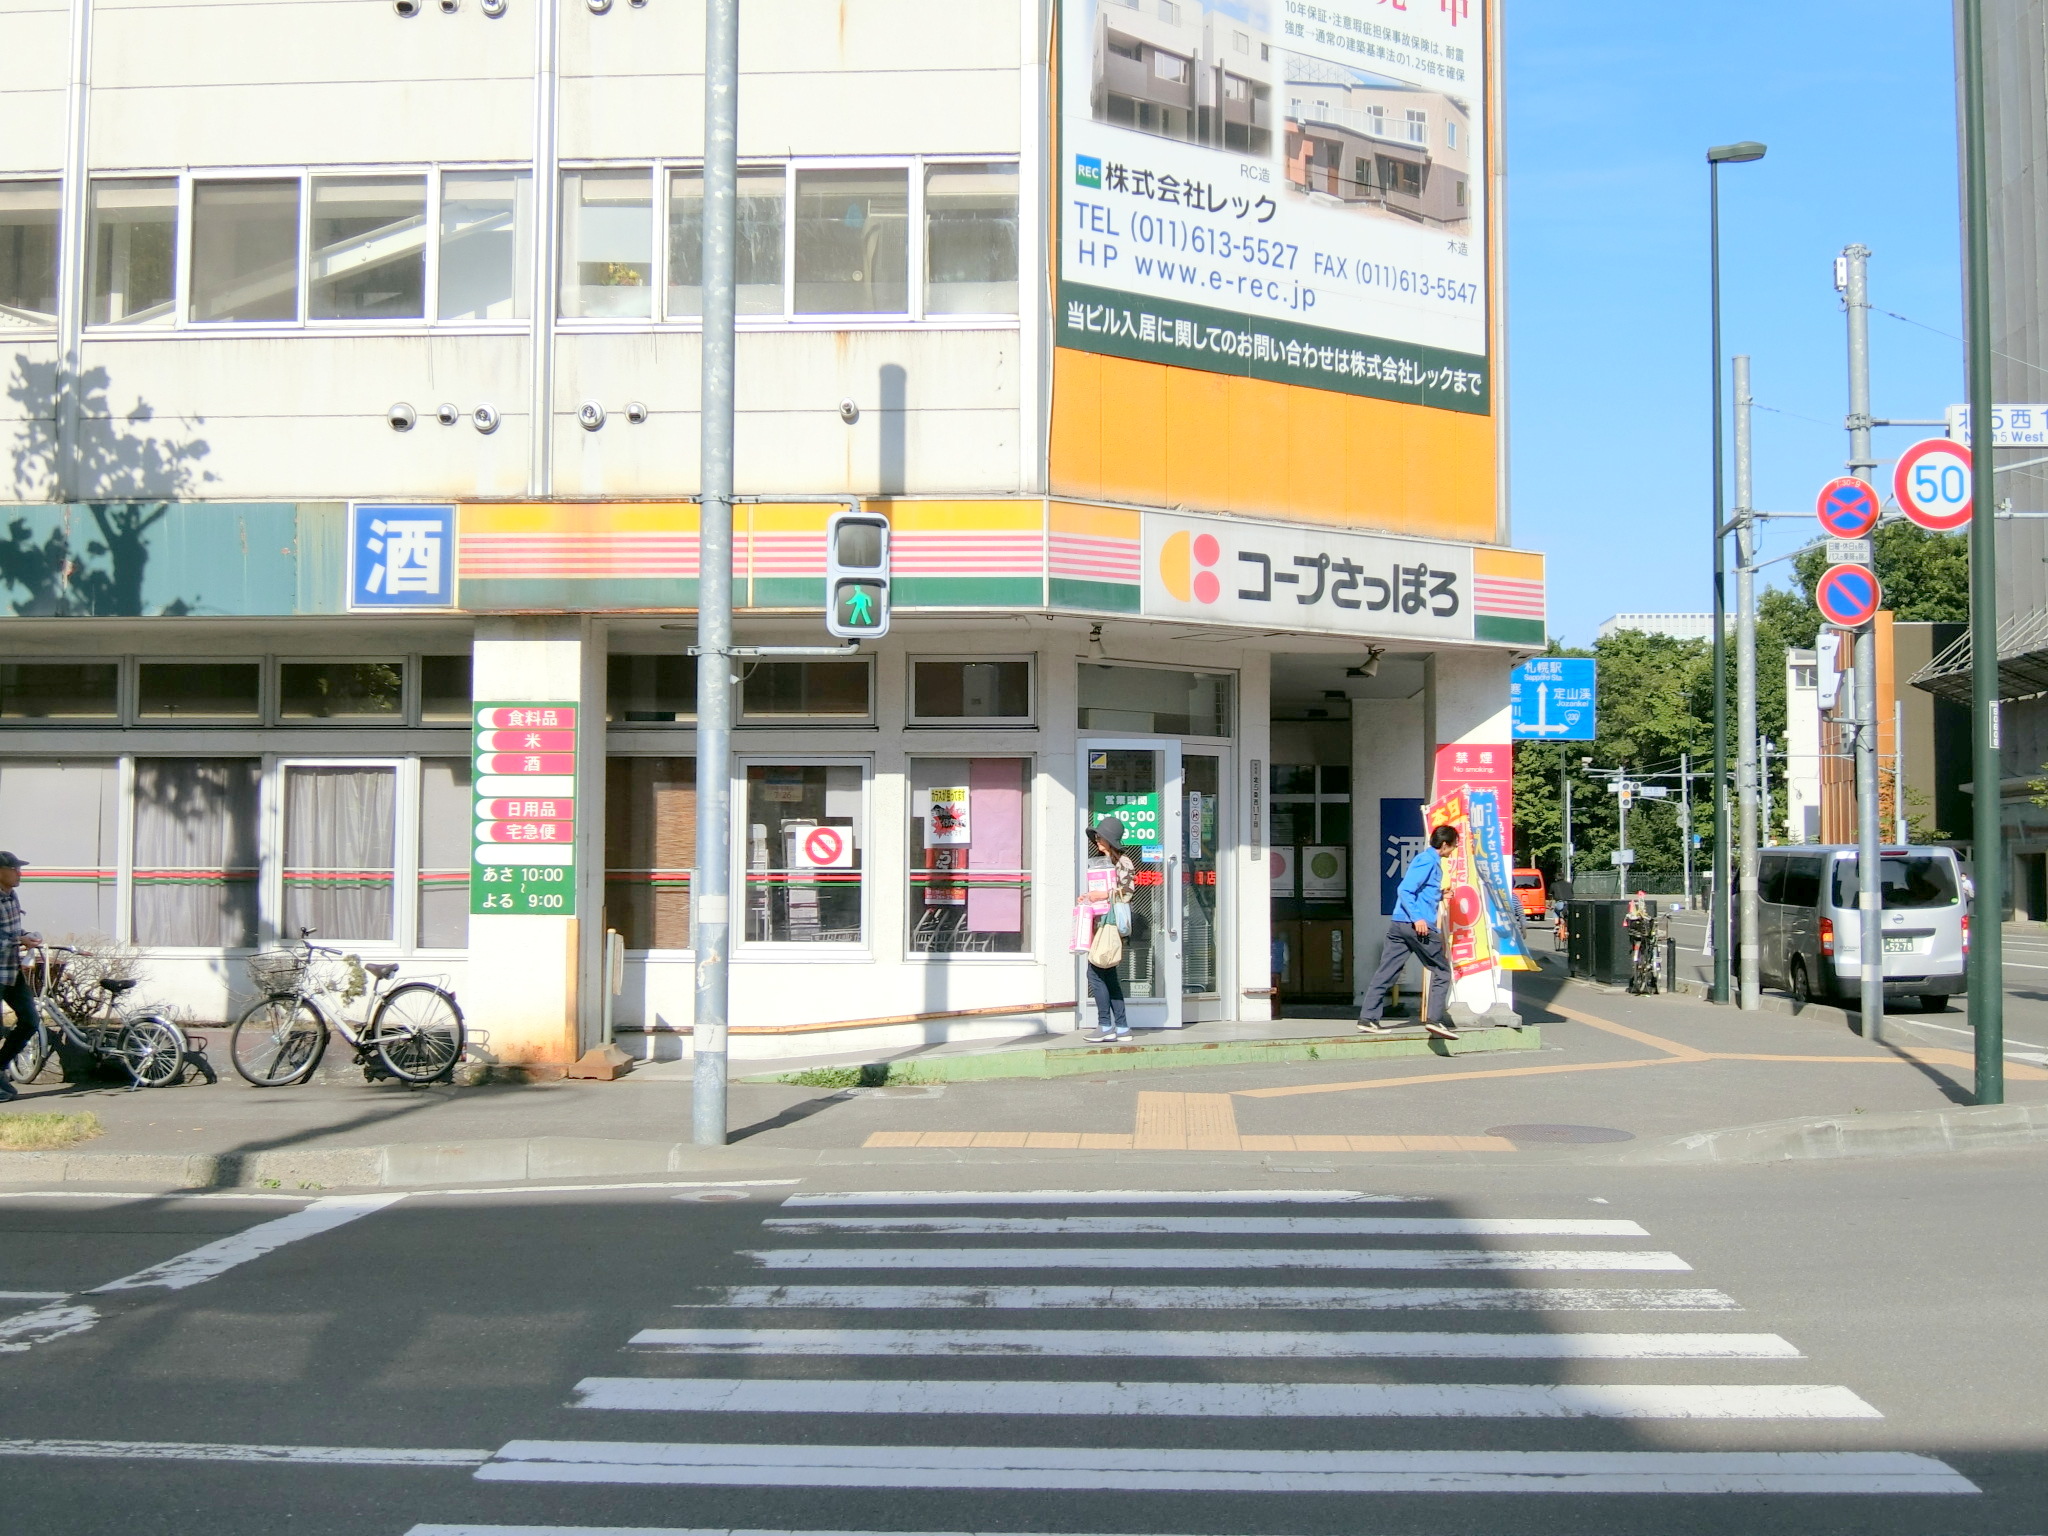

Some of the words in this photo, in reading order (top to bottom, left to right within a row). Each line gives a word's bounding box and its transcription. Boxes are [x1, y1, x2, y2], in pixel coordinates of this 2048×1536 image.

[1078, 165, 1099, 179] REC
[1240, 164, 1270, 183] RC造
[1105, 161, 1276, 223] 株式会社レック
[1073, 200, 1120, 236] TEL
[1130, 211, 1298, 270] (011)613-5527
[1314, 252, 1348, 280] FAX
[1356, 259, 1477, 304] (011)613-5547
[1447, 239, 1469, 256] 木造
[1134, 256, 1315, 311] www.e-rec.jp
[1067, 301, 1481, 396] 当ビル入居に関してのお問い合わせは株式会社レックまで
[2011, 431, 2044, 442] West
[1915, 465, 1964, 503] 50
[365, 518, 442, 594] 酒
[1238, 550, 1459, 618] コープさっぽろ
[1524, 661, 1562, 674] 札幌駅
[1553, 688, 1591, 700] 定山渓
[508, 710, 558, 727] 食料品
[1567, 713, 1579, 721] 230
[524, 732, 541, 749] 米
[523, 756, 541, 772] 酒
[1456, 752, 1493, 763] 禁煙
[508, 802, 556, 817] 日用品
[1114, 810, 1156, 822] 10:00
[506, 823, 556, 840] 宅急便
[1485, 802, 1503, 885] コープさっぽろ
[483, 867, 514, 882] あさ
[521, 867, 563, 882] 10:00
[482, 894, 514, 908] よる
[528, 894, 563, 908] 9:00
